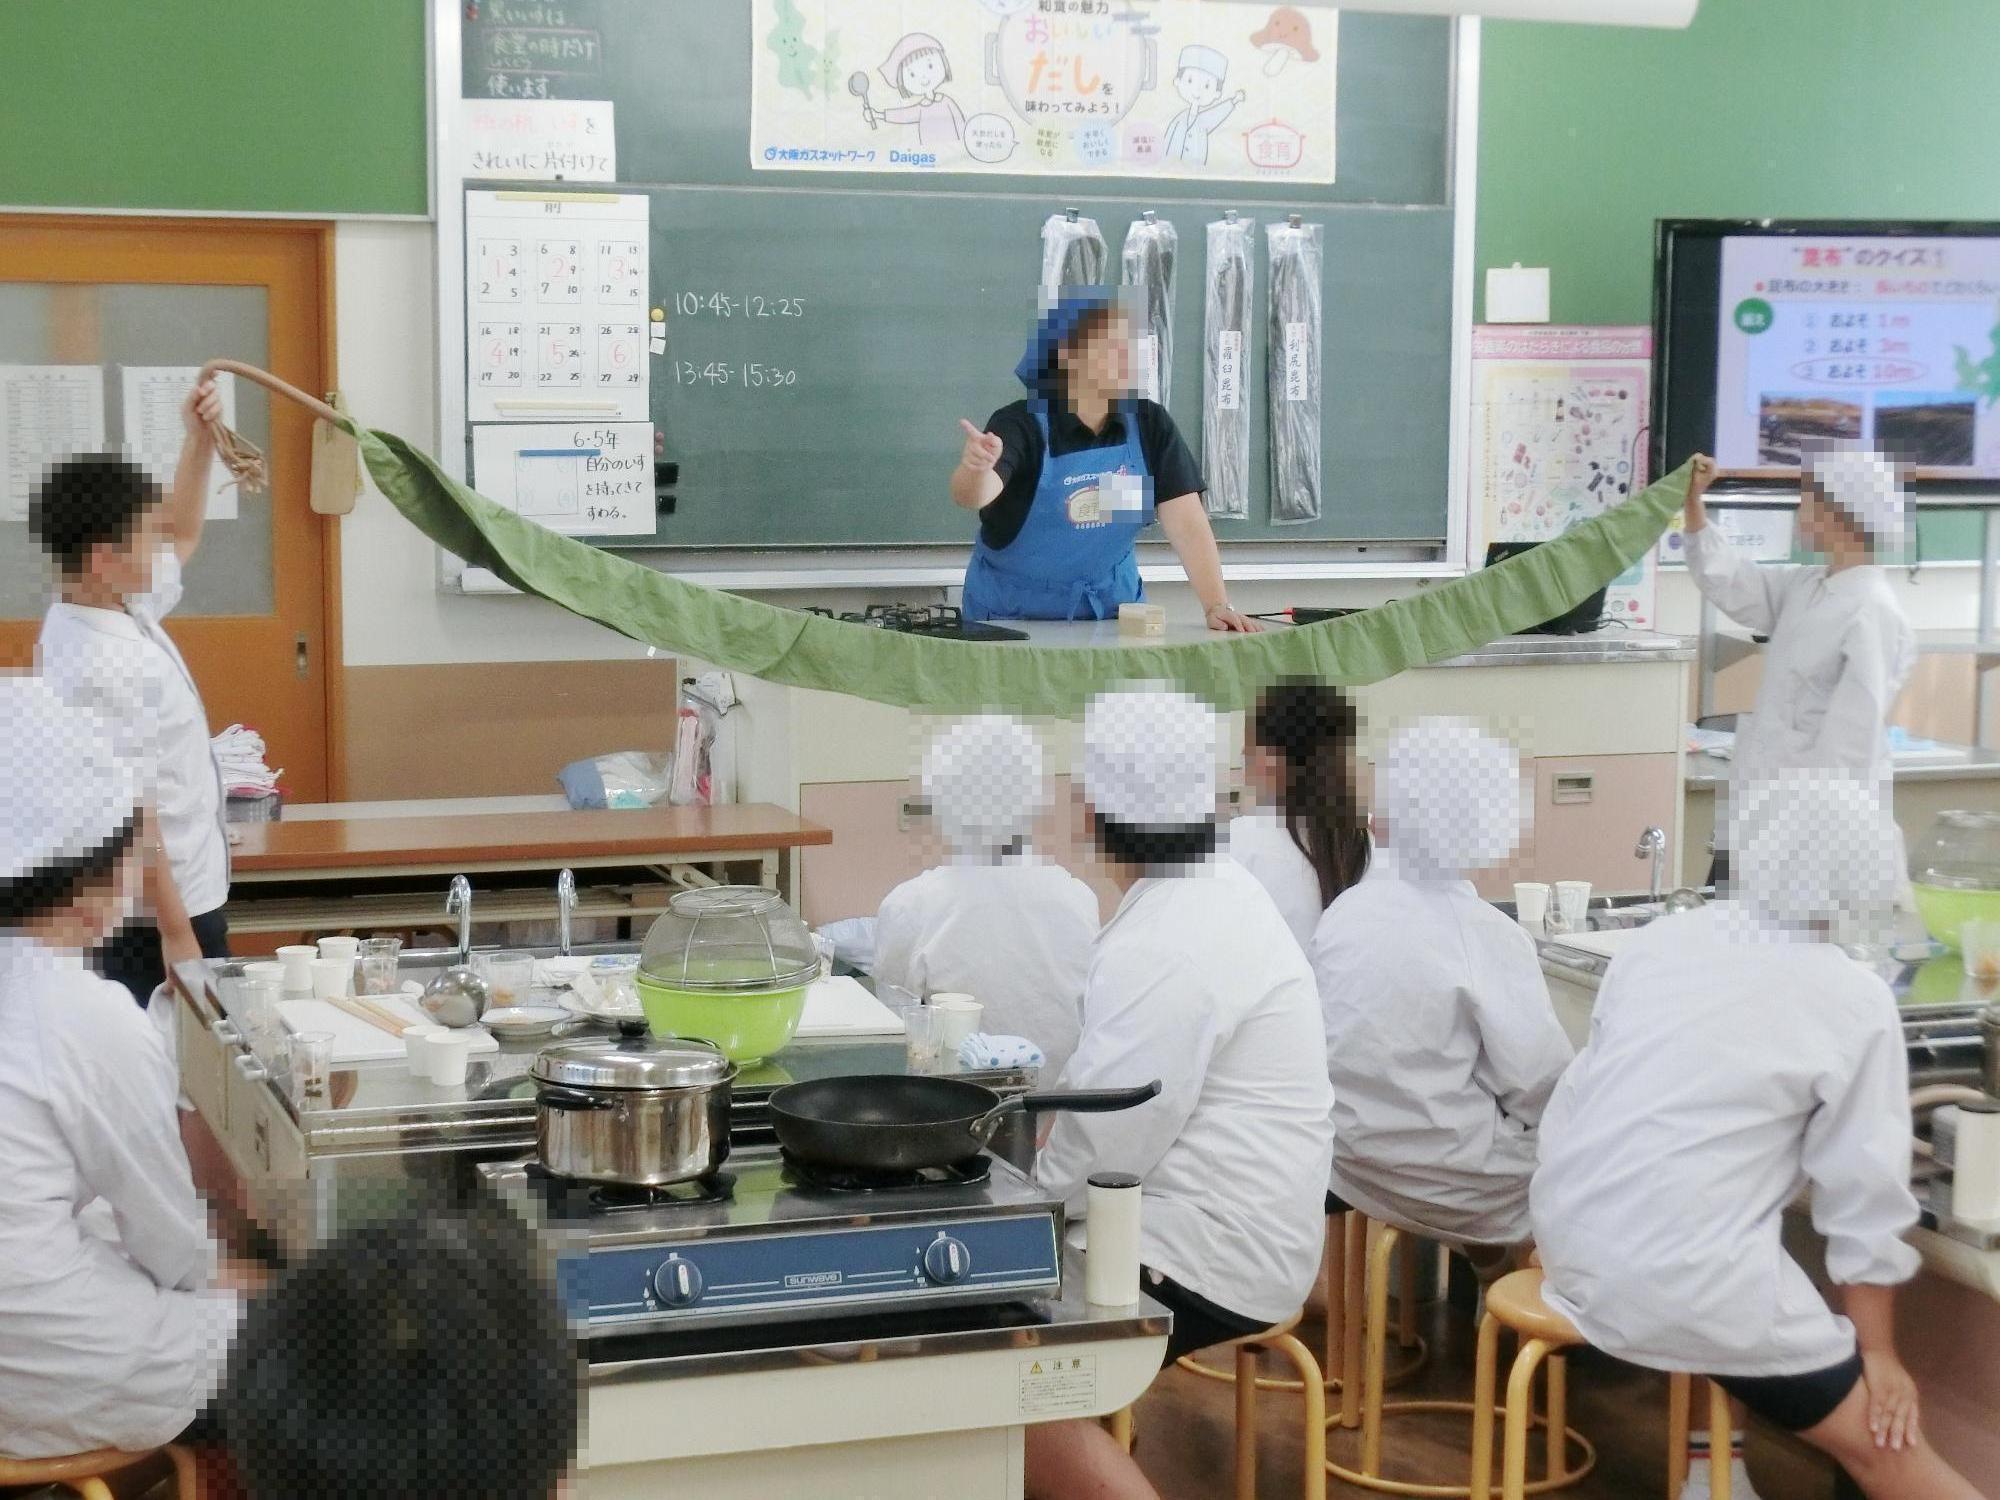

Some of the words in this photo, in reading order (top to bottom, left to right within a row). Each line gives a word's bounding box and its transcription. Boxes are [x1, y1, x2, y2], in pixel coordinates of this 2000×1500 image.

[1024, 15, 1111, 44] おいしい
[778, 149, 876, 161] 大阪ガスネットワーク
[890, 150, 937, 165] Daigas
[509, 245, 518, 256] 3
[541, 244, 548, 254] 6
[509, 268, 516, 277] 4
[481, 281, 490, 294] 2
[511, 288, 518, 297] 5
[541, 282, 550, 294] 7
[568, 285, 578, 294] 10
[601, 285, 611, 293] 12
[630, 289, 638, 297] 15
[540, 327, 550, 336] 21
[586, 453, 646, 472] 自分のいす
[585, 481, 642, 496] を持ってきて
